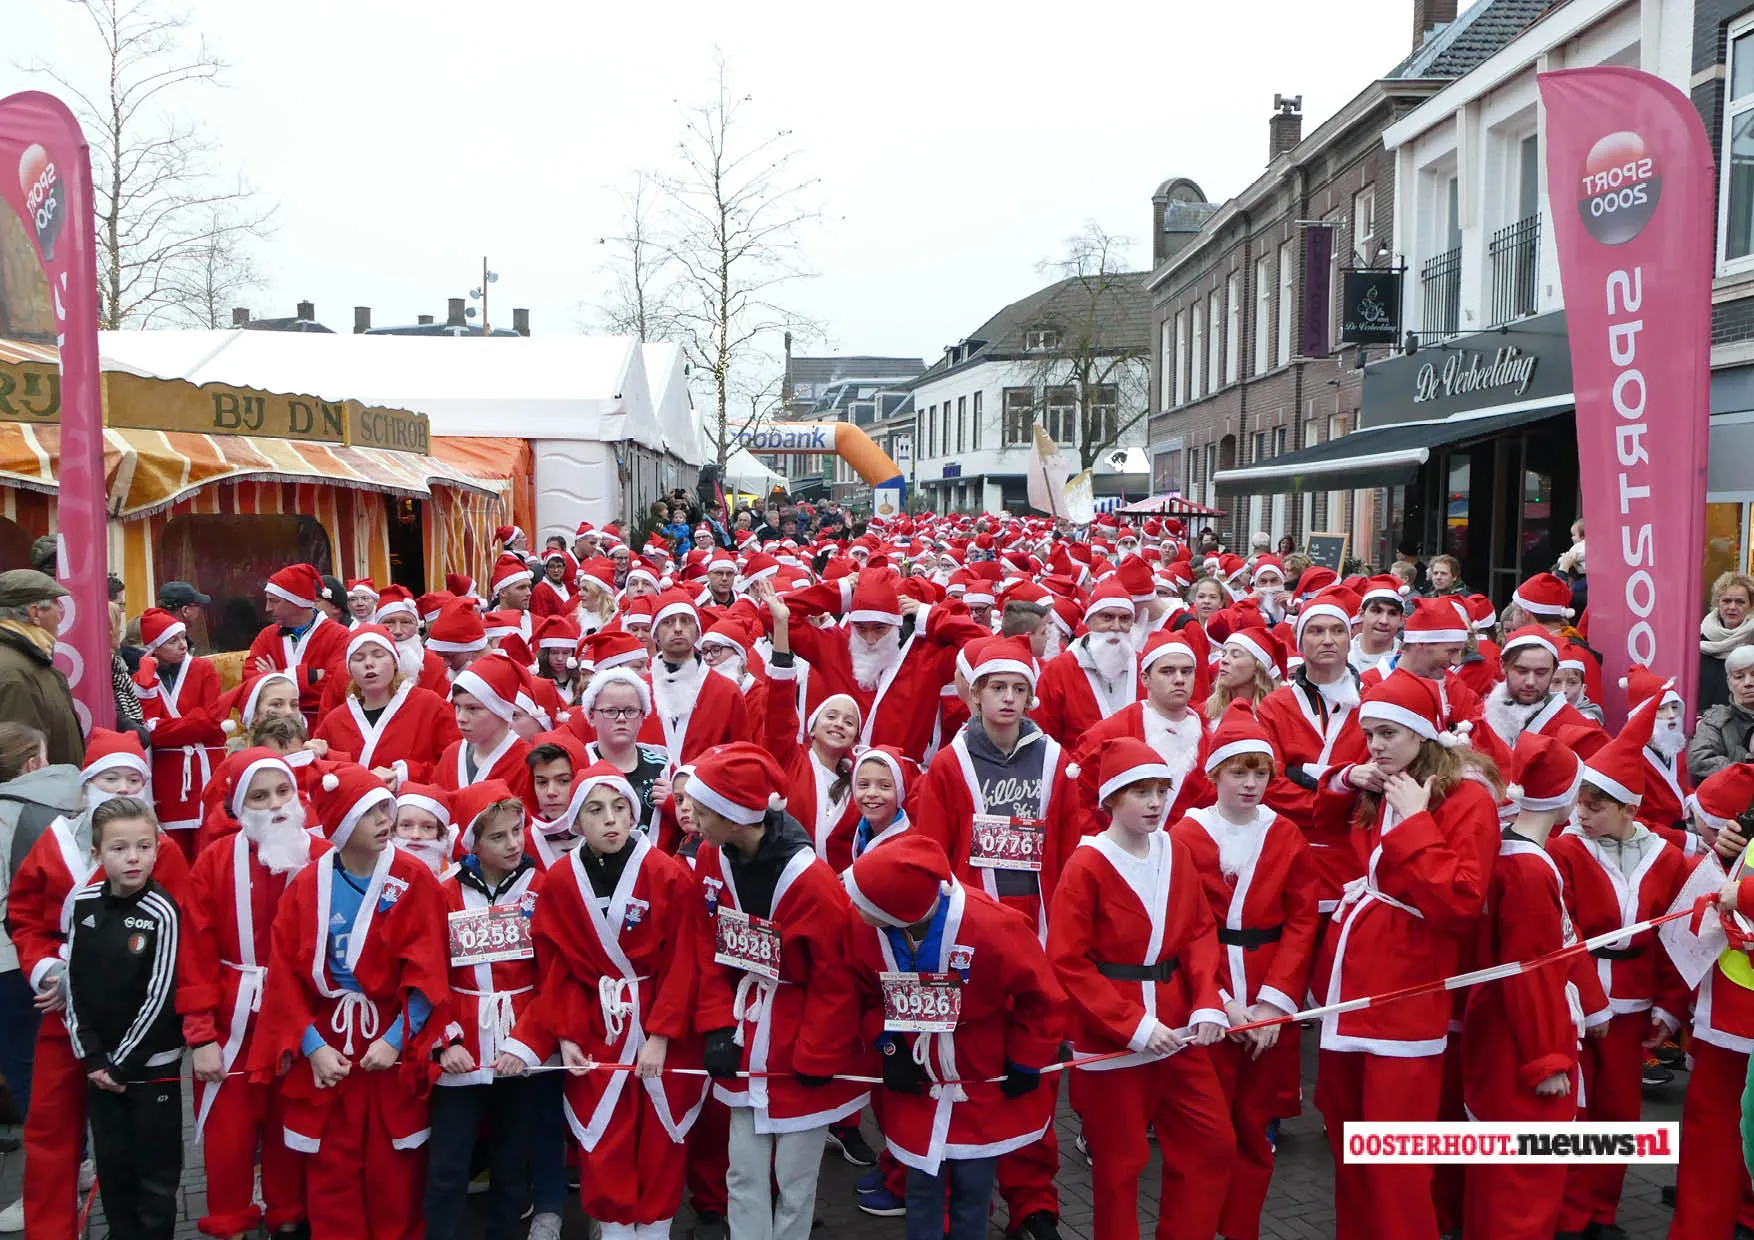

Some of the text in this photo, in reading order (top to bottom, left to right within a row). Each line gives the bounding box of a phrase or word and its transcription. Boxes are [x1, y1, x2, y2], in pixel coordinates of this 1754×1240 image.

[1413, 345, 1535, 403] De Verbeelding
[982, 835, 1033, 855] 0776
[462, 924, 520, 949] 0258
[727, 931, 771, 960] 0928
[896, 994, 950, 1016] 0926
